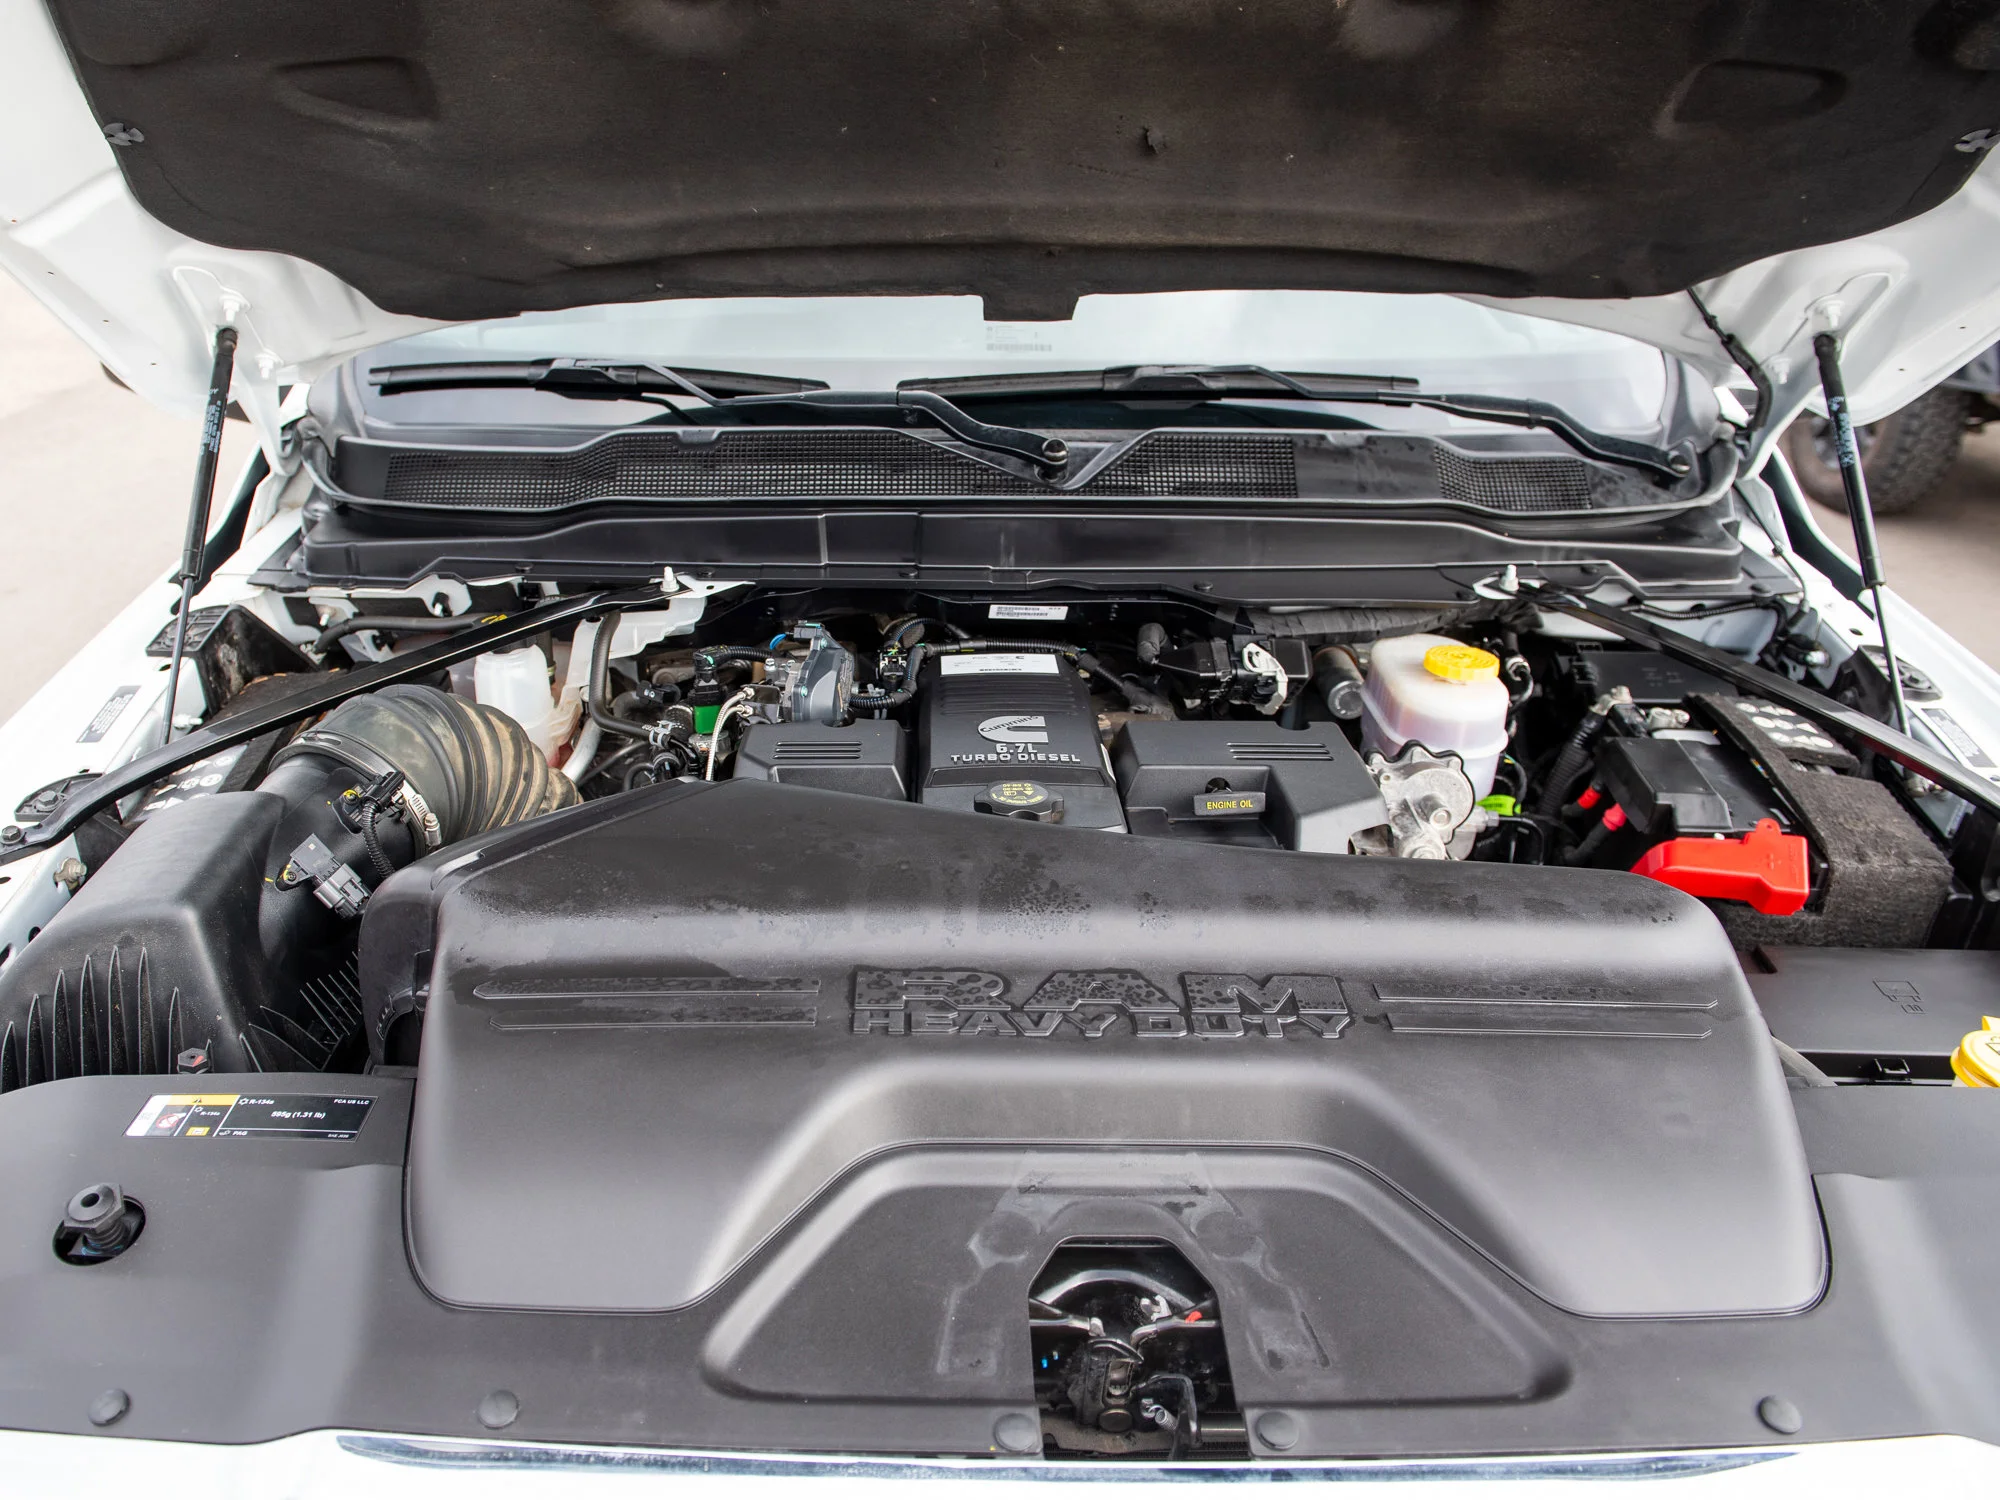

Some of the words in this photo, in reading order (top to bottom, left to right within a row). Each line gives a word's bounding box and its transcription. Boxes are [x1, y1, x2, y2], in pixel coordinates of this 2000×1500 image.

[980, 715, 1039, 732] Cummins
[995, 743, 1038, 753] 6.7L
[951, 753, 1012, 762] TURBO
[1017, 753, 1081, 762] DIESEL
[1206, 800, 1238, 810] ENGINE
[1239, 799, 1254, 809] OIL
[854, 971, 1349, 1012] RAM
[852, 1011, 1118, 1037] HEAVY
[1132, 1011, 1351, 1039] DUTY
[292, 1110, 313, 1119] (1.31
[313, 1111, 327, 1119] lb)
